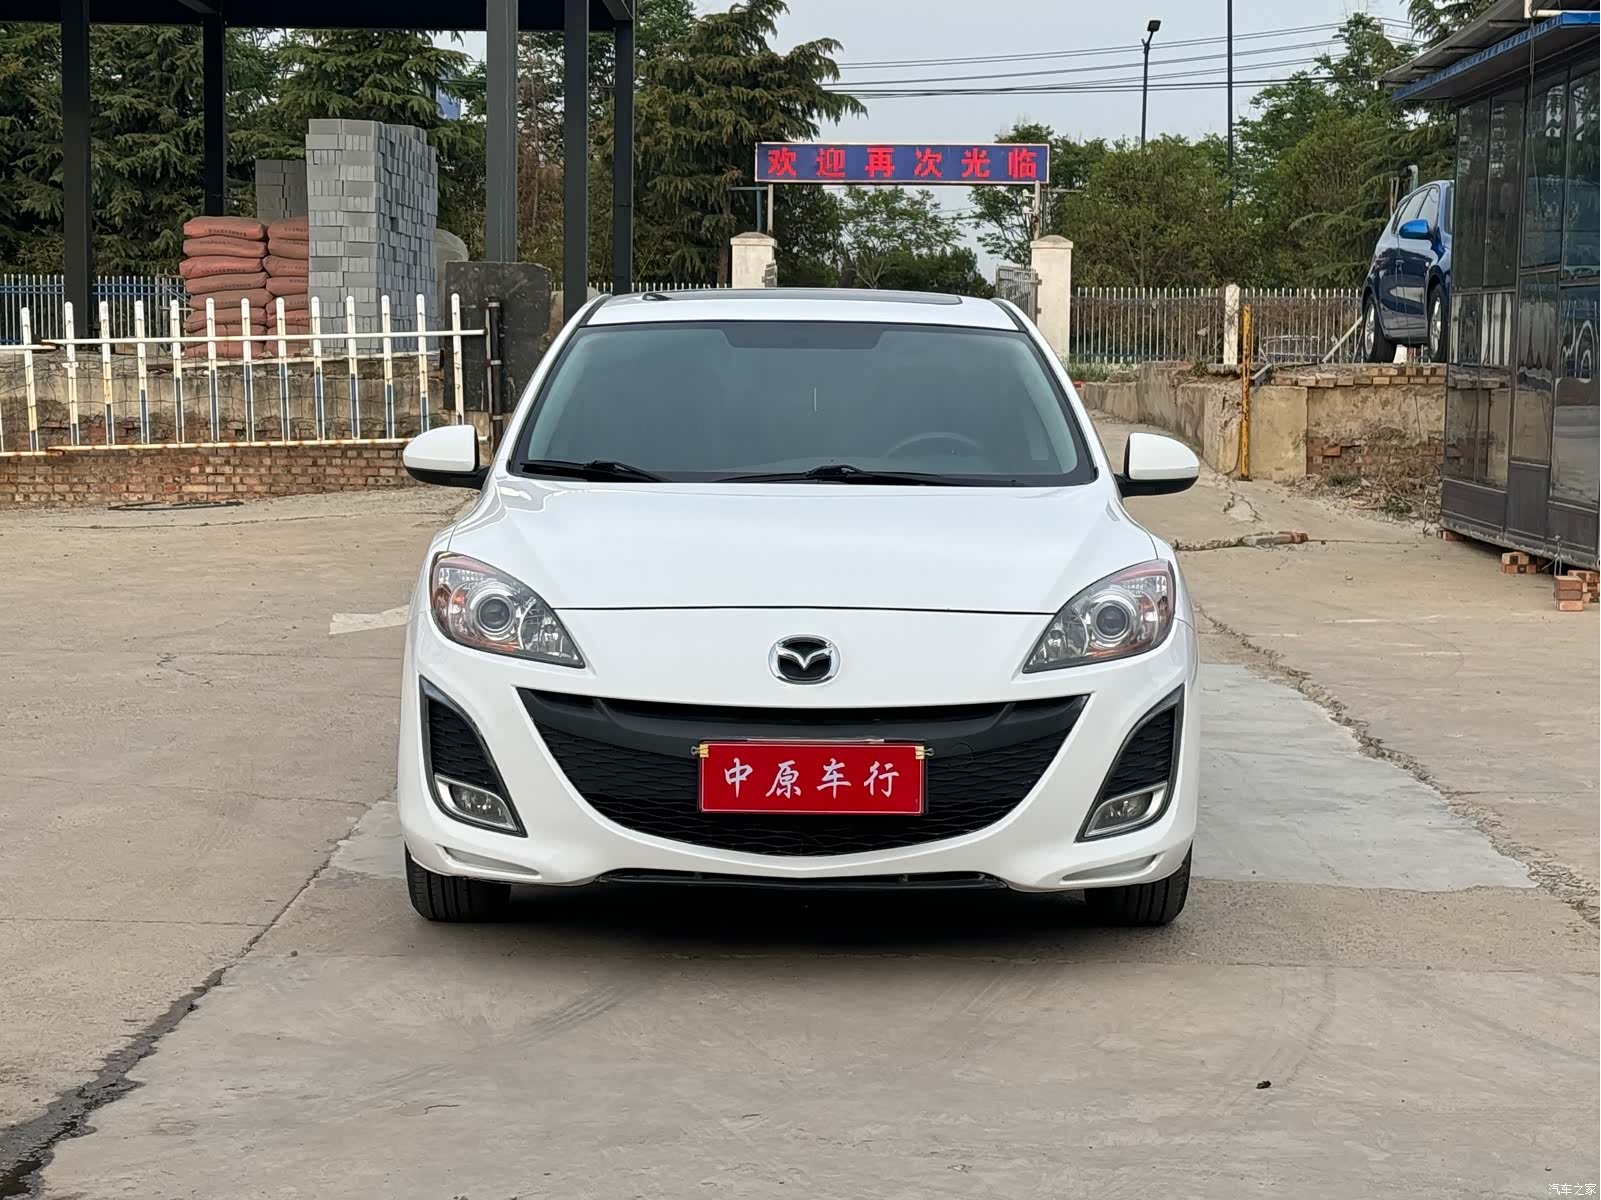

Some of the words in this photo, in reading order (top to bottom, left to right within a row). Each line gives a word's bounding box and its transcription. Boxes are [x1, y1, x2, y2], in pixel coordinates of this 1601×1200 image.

[767, 146, 1037, 178] 欢迎再次光临
[724, 757, 900, 799] 中原车行
